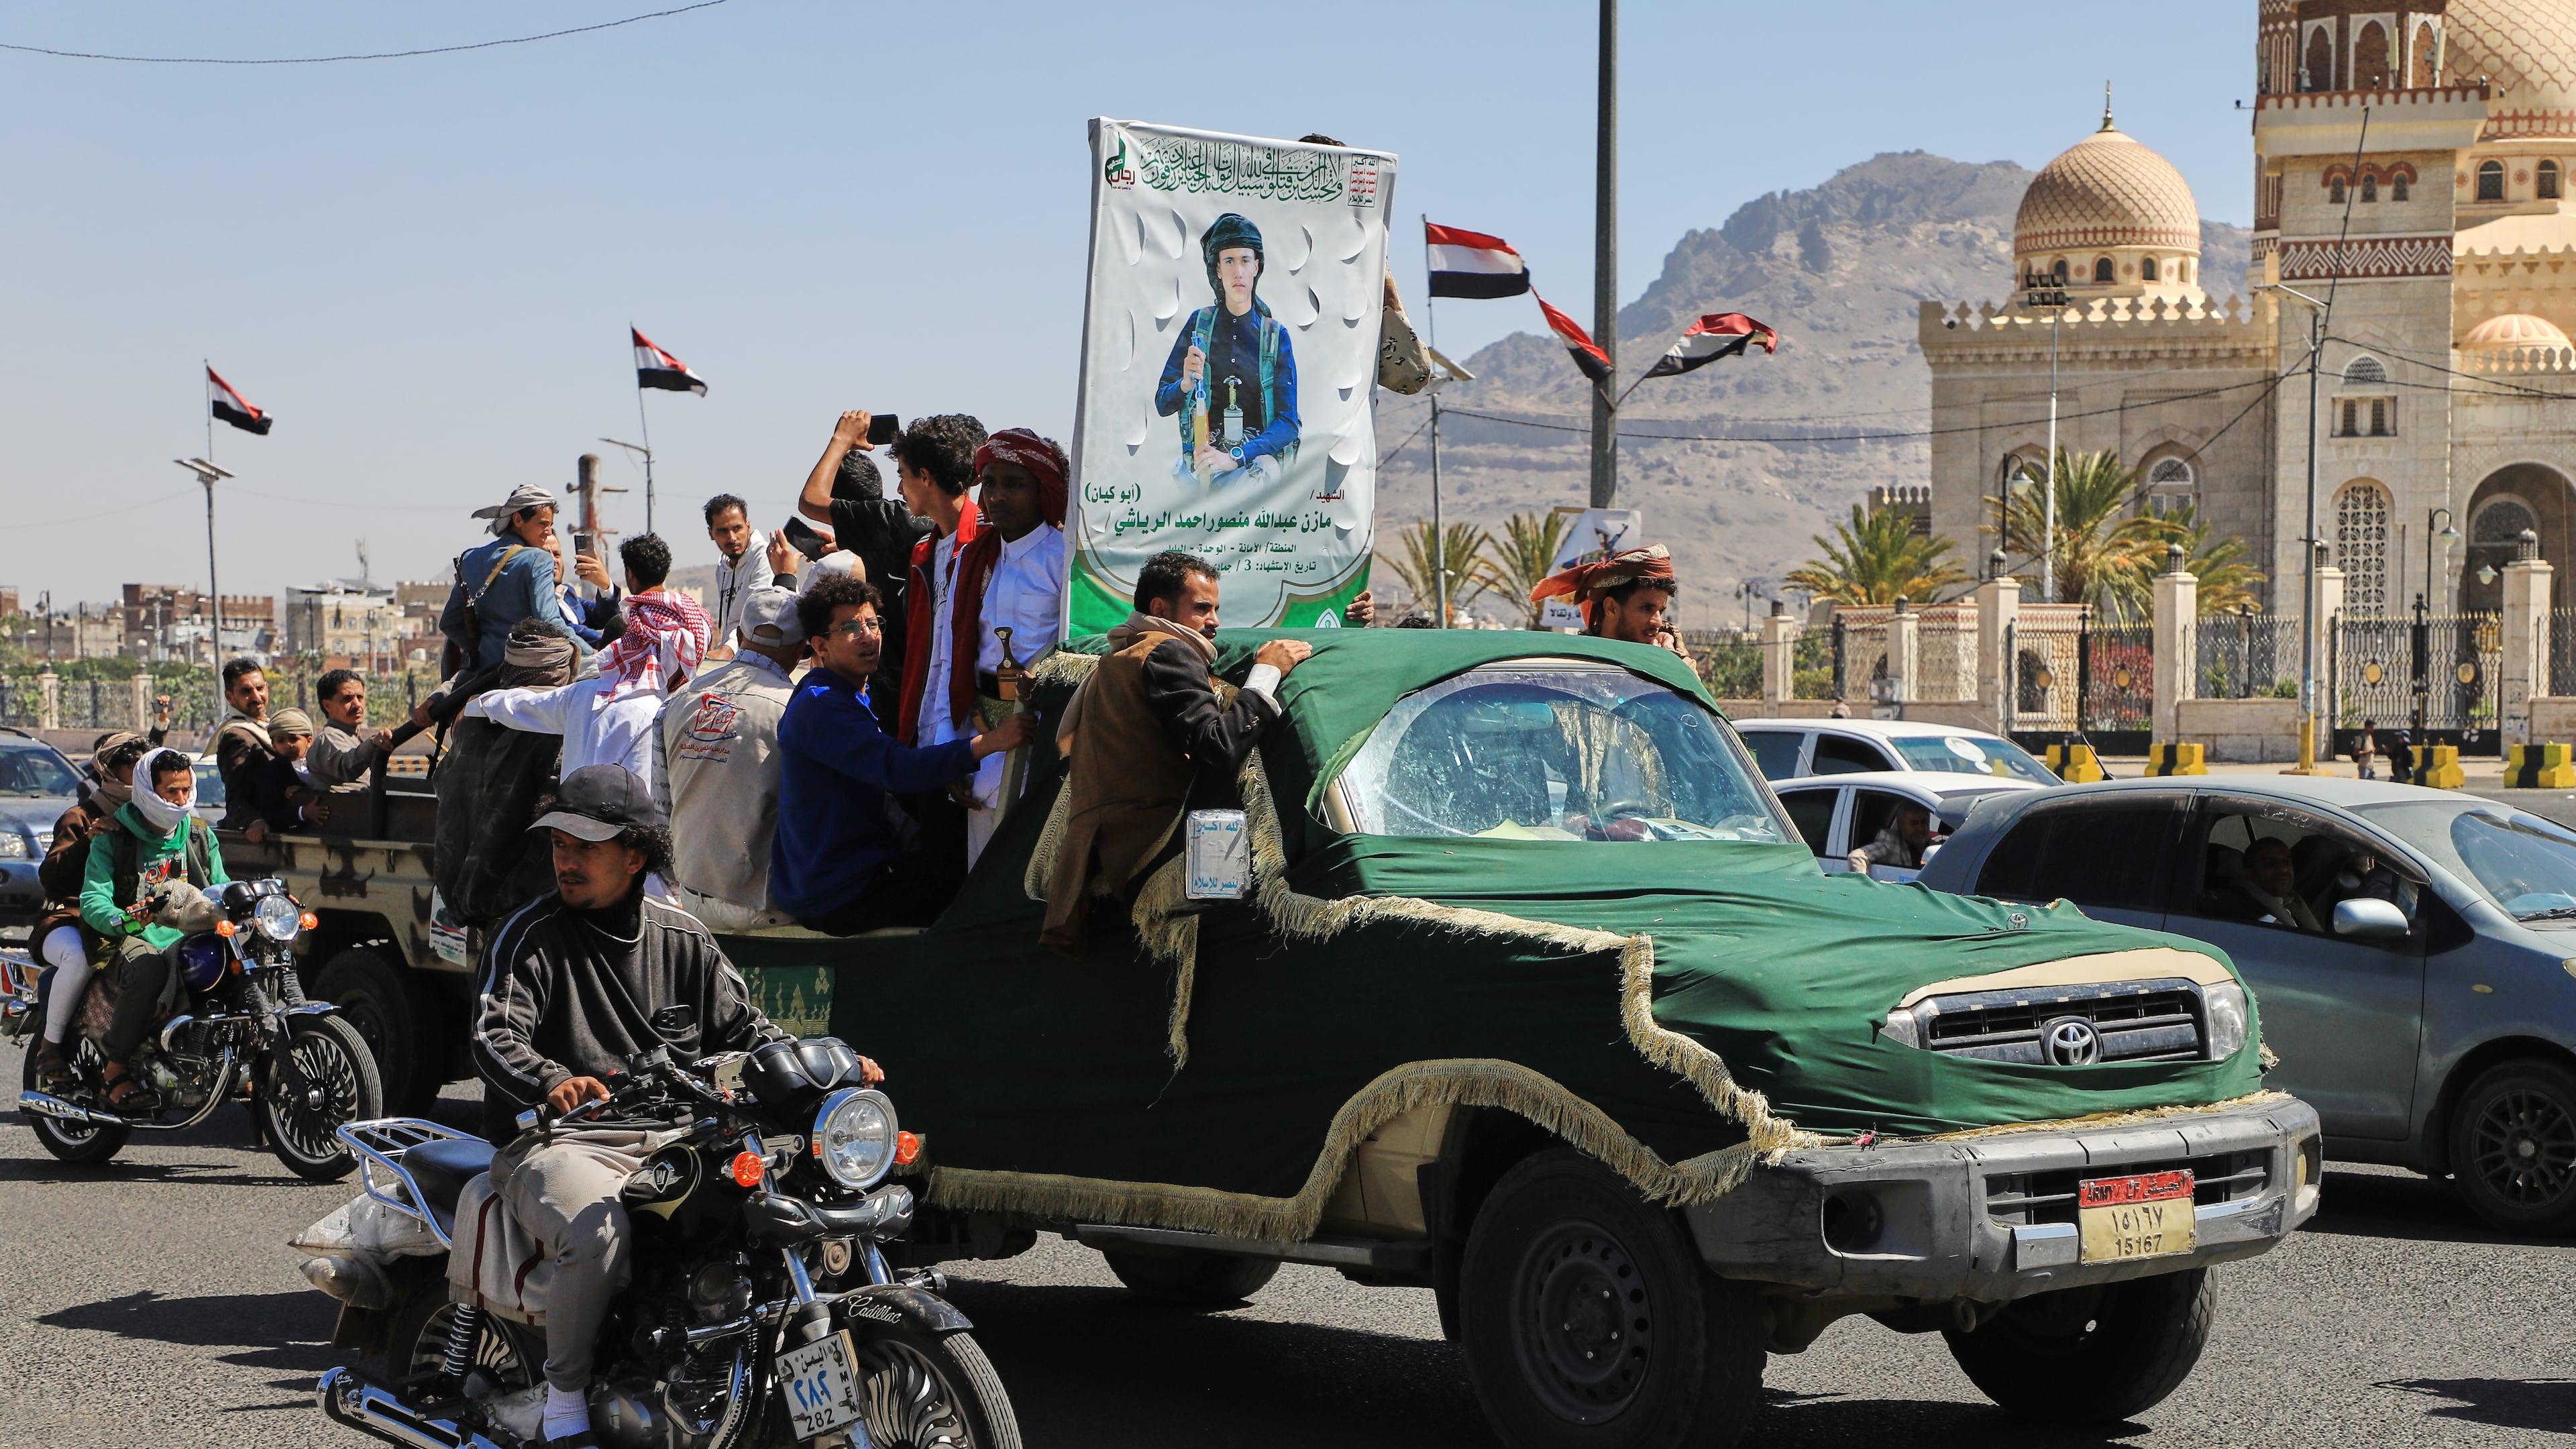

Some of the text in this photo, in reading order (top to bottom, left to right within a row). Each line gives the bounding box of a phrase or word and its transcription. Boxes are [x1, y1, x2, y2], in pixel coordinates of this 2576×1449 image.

[1316, 489, 1344, 503] الشهيد
[1114, 508, 1171, 537] الرياشي
[1301, 511, 1331, 533] مازن
[1244, 559, 1252, 571] 3
[1294, 561, 1317, 574] تاريخ
[2112, 1205, 2163, 1233] ١٥١٦٧
[2115, 1233, 2163, 1256] 15167
[848, 1295, 902, 1324] Cadillac
[801, 1344, 828, 1374] اليمن
[805, 1407, 835, 1432] 282
